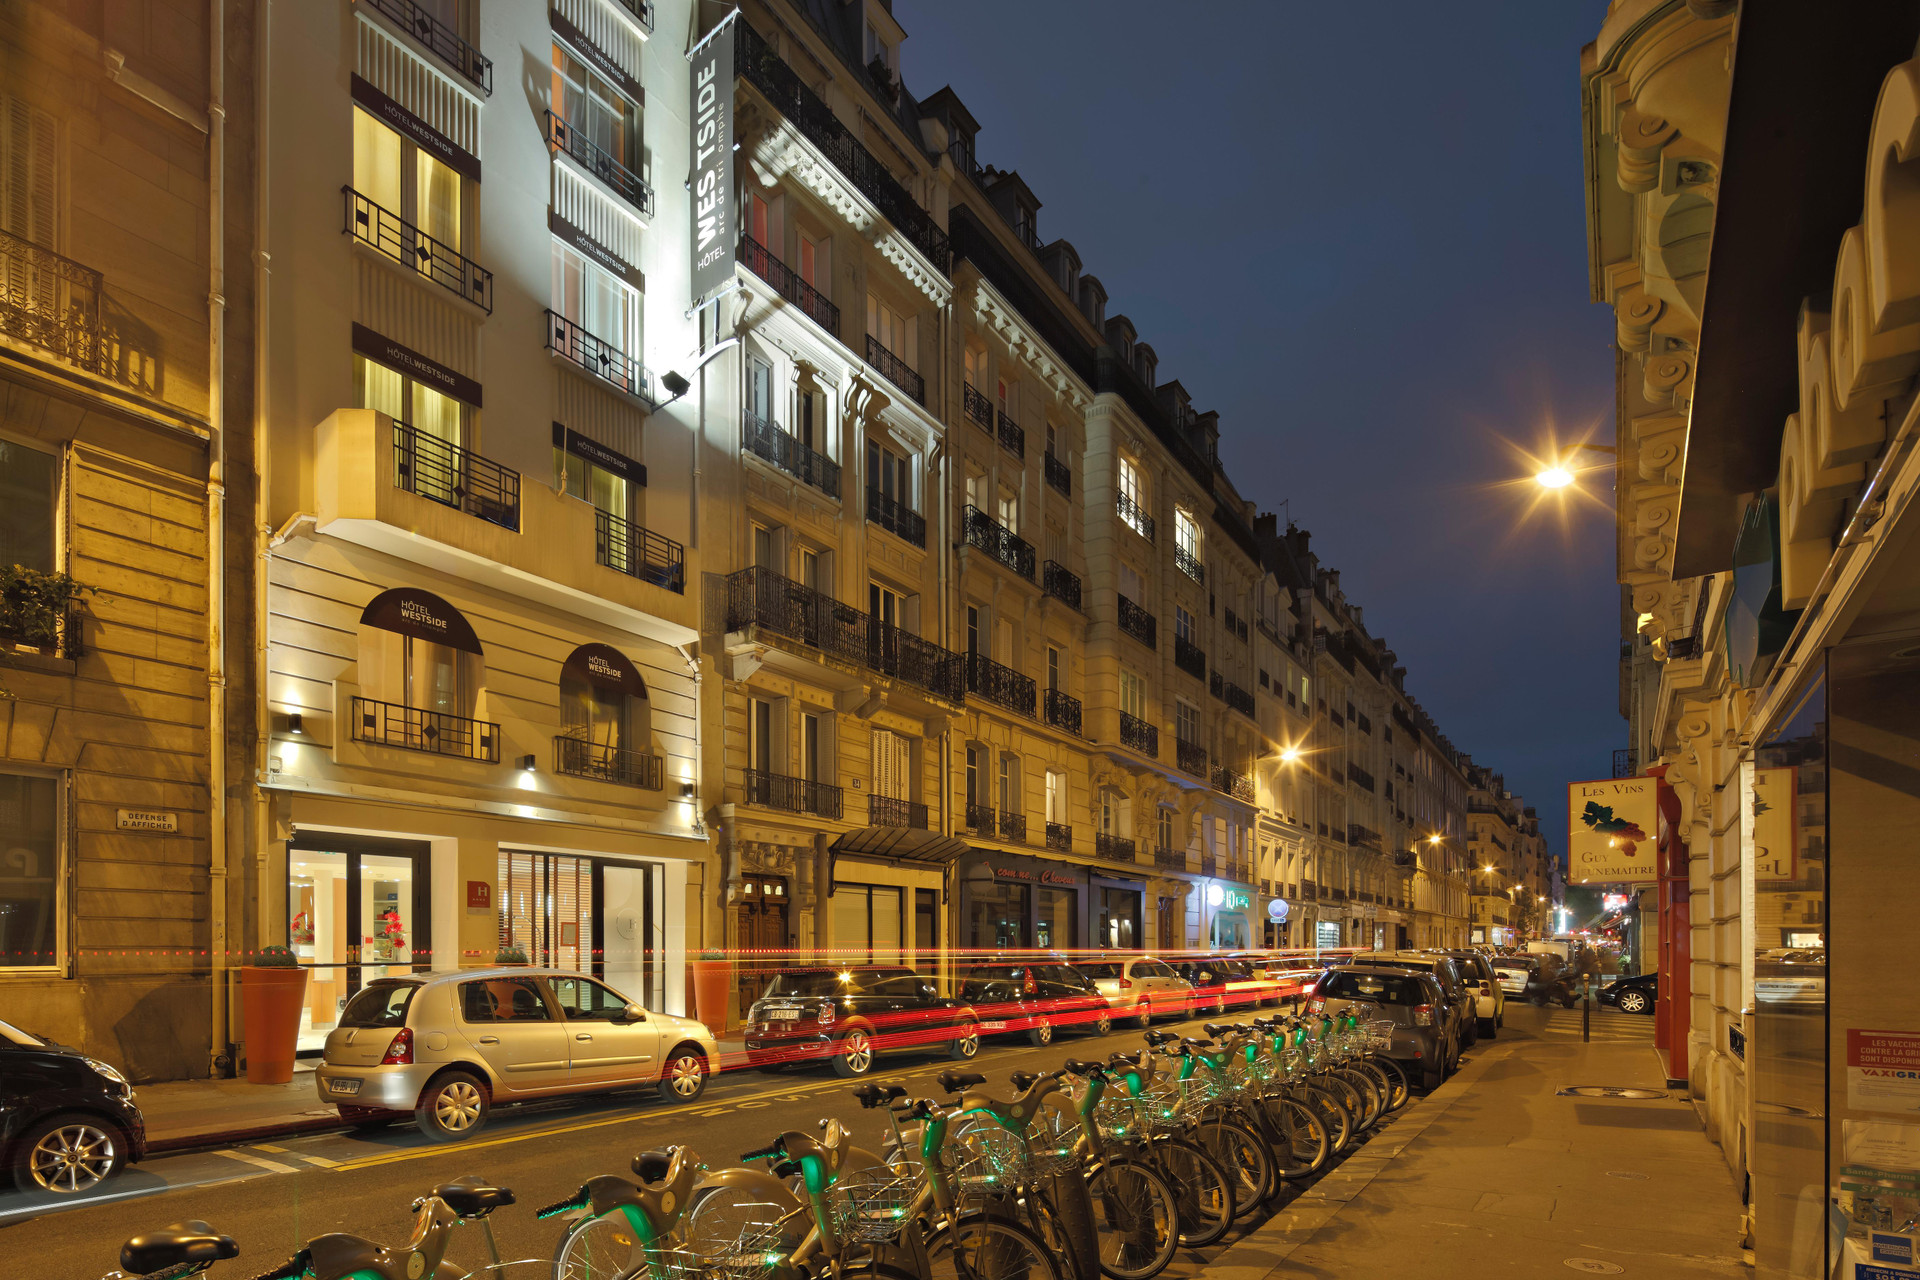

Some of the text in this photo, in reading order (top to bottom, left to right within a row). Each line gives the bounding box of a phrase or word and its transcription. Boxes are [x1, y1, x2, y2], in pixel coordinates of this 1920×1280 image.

[697, 59, 716, 252] WESTSIDE
[697, 246, 726, 271] HÔTEL
[401, 600, 430, 615] HÔTEL
[401, 609, 447, 629] WESTSIDE
[588, 655, 609, 668] HÔTEL
[588, 663, 621, 678] WESTSIDE
[1582, 783, 1644, 797] LES VINS
[128, 813, 167, 822] DEFENSE
[122, 820, 173, 830] D'AFFICHER
[1581, 851, 1609, 864] GUY
[477, 886, 488, 897] H
[1860, 1047, 1891, 1055] CONTRE
[1861, 1069, 1920, 1079] VAXIGR
